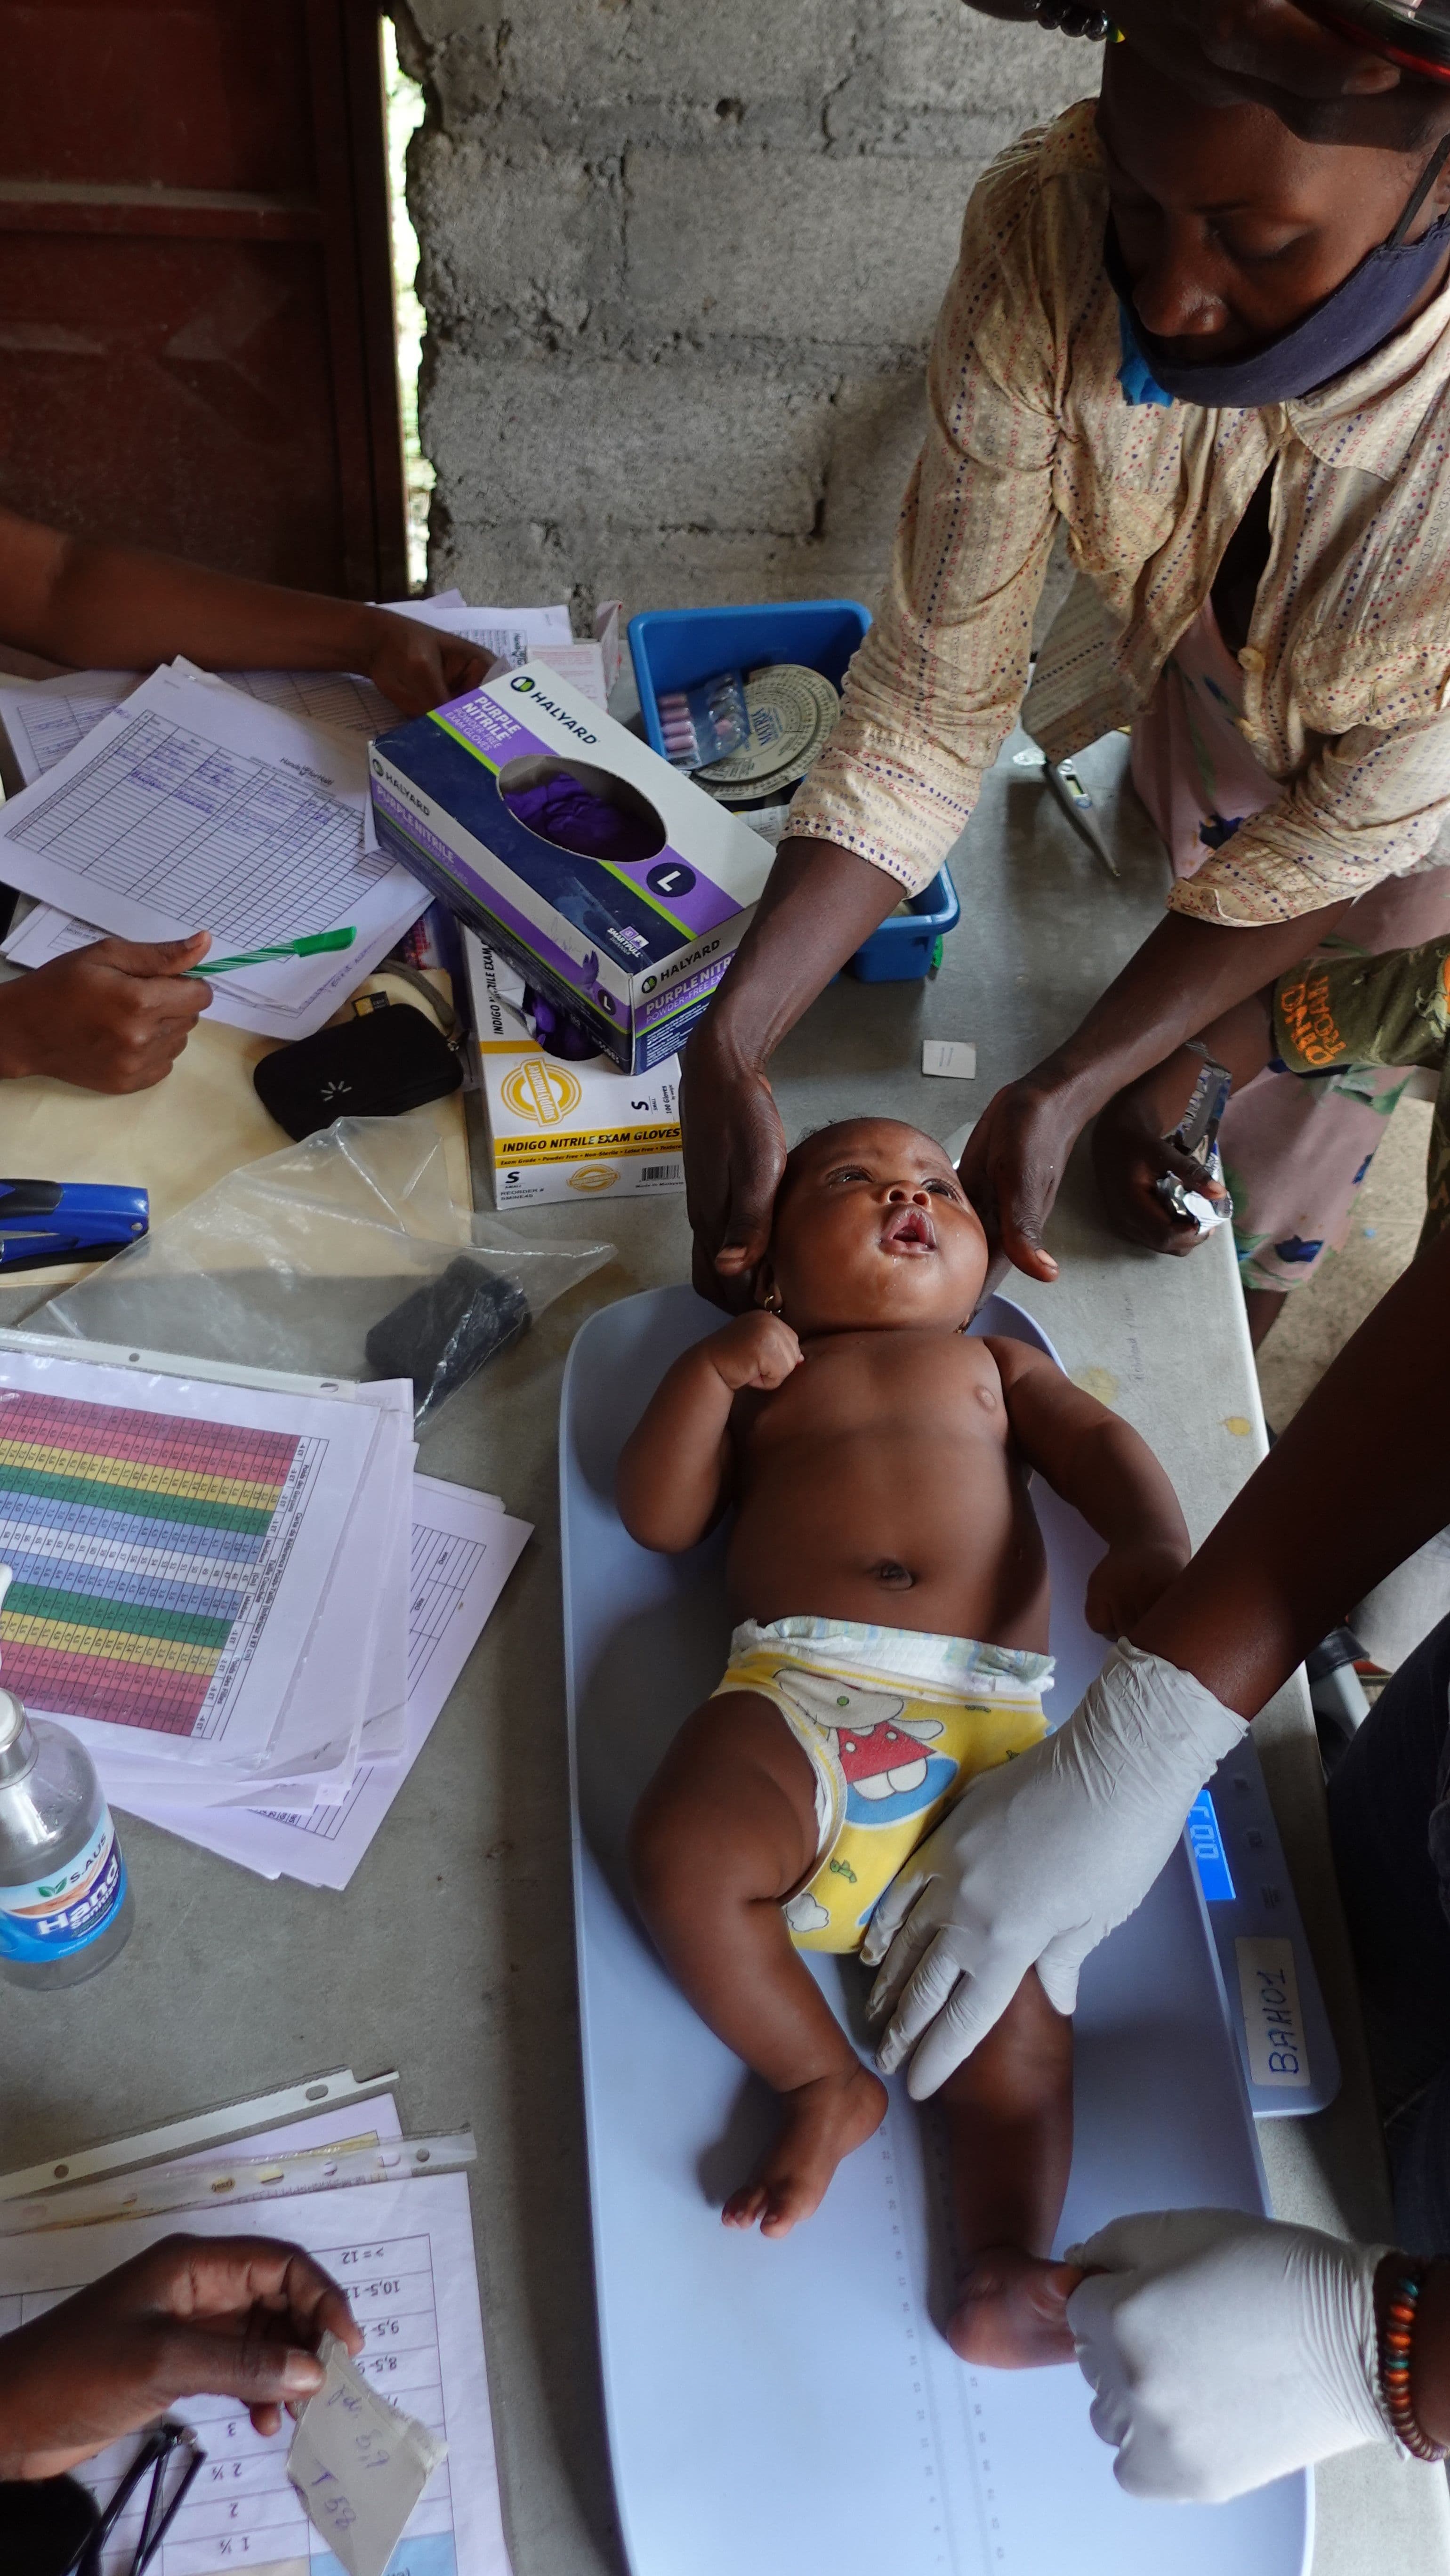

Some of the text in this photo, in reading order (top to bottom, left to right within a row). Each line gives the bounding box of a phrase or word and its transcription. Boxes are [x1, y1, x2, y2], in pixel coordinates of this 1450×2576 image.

[462, 702, 510, 741] NITRILE
[474, 696, 522, 734] PURPLE
[531, 692, 597, 744] HALYARD
[386, 772, 430, 816] HALYARD
[658, 870, 681, 893] L
[607, 927, 641, 958] SMARTPULL
[661, 940, 721, 982] HALYARD
[603, 996, 611, 1011] L
[646, 976, 699, 1015] PURPLE
[646, 981, 709, 1024] POWDER-FREE
[490, 1005, 504, 1035] INDIGO
[631, 1101, 649, 1111] S
[664, 1104, 672, 1114] 100
[502, 1128, 680, 1153] INDIGO NITRILE EXAM GLOVES
[505, 1171, 521, 1184] S
[266, 1559, 276, 1575] Taille
[224, 1675, 233, 1686] des
[38, 1853, 118, 1936] Hand
[341, 2250, 359, 2264] 12
[227, 2422, 236, 2437] 3
[233, 2462, 242, 2477] 2
[229, 2502, 239, 2519] 2
[242, 2536, 250, 2552] 1
